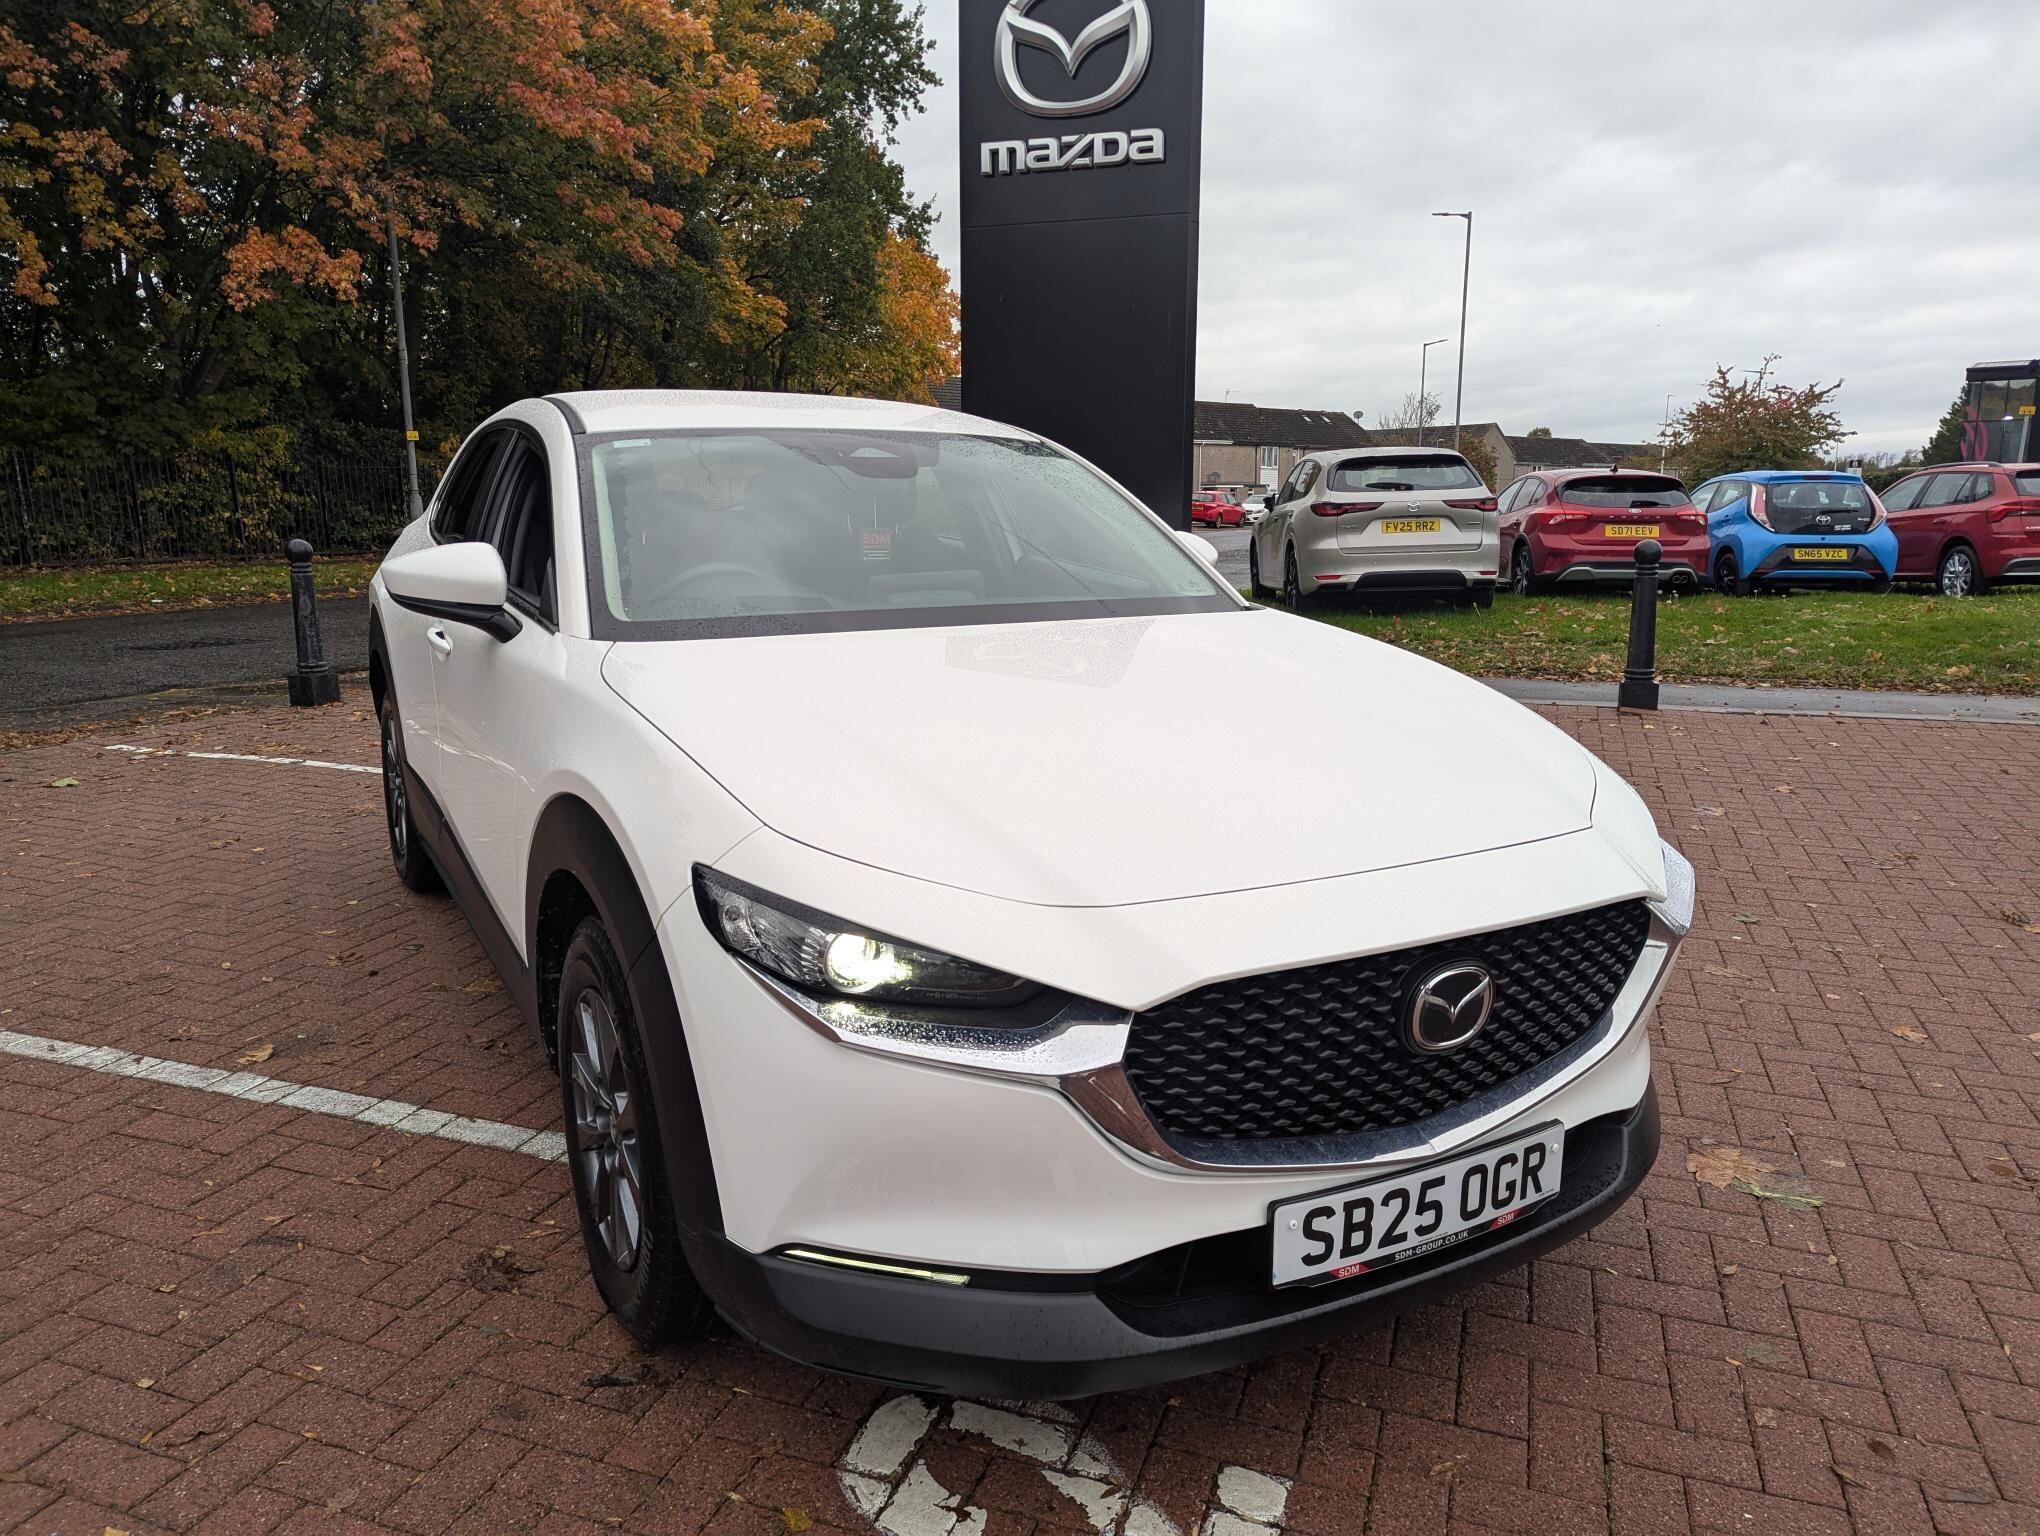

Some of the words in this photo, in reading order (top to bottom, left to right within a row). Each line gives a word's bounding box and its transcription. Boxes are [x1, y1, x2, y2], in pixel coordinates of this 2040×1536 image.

[1385, 521, 1413, 532] FV25
[1415, 520, 1436, 531] RRZ
[1611, 526, 1633, 535] SD71
[1635, 526, 1654, 535] EEV
[1797, 549, 1822, 558] SN65
[1823, 549, 1843, 558] VZC
[1300, 1175, 1446, 1267] SB25
[1459, 1141, 1547, 1222] OGR
[1497, 1212, 1514, 1225] SDM
[1394, 1229, 1469, 1261] SDM-GROUP.CO.UK
[1338, 1263, 1360, 1277] SDM
